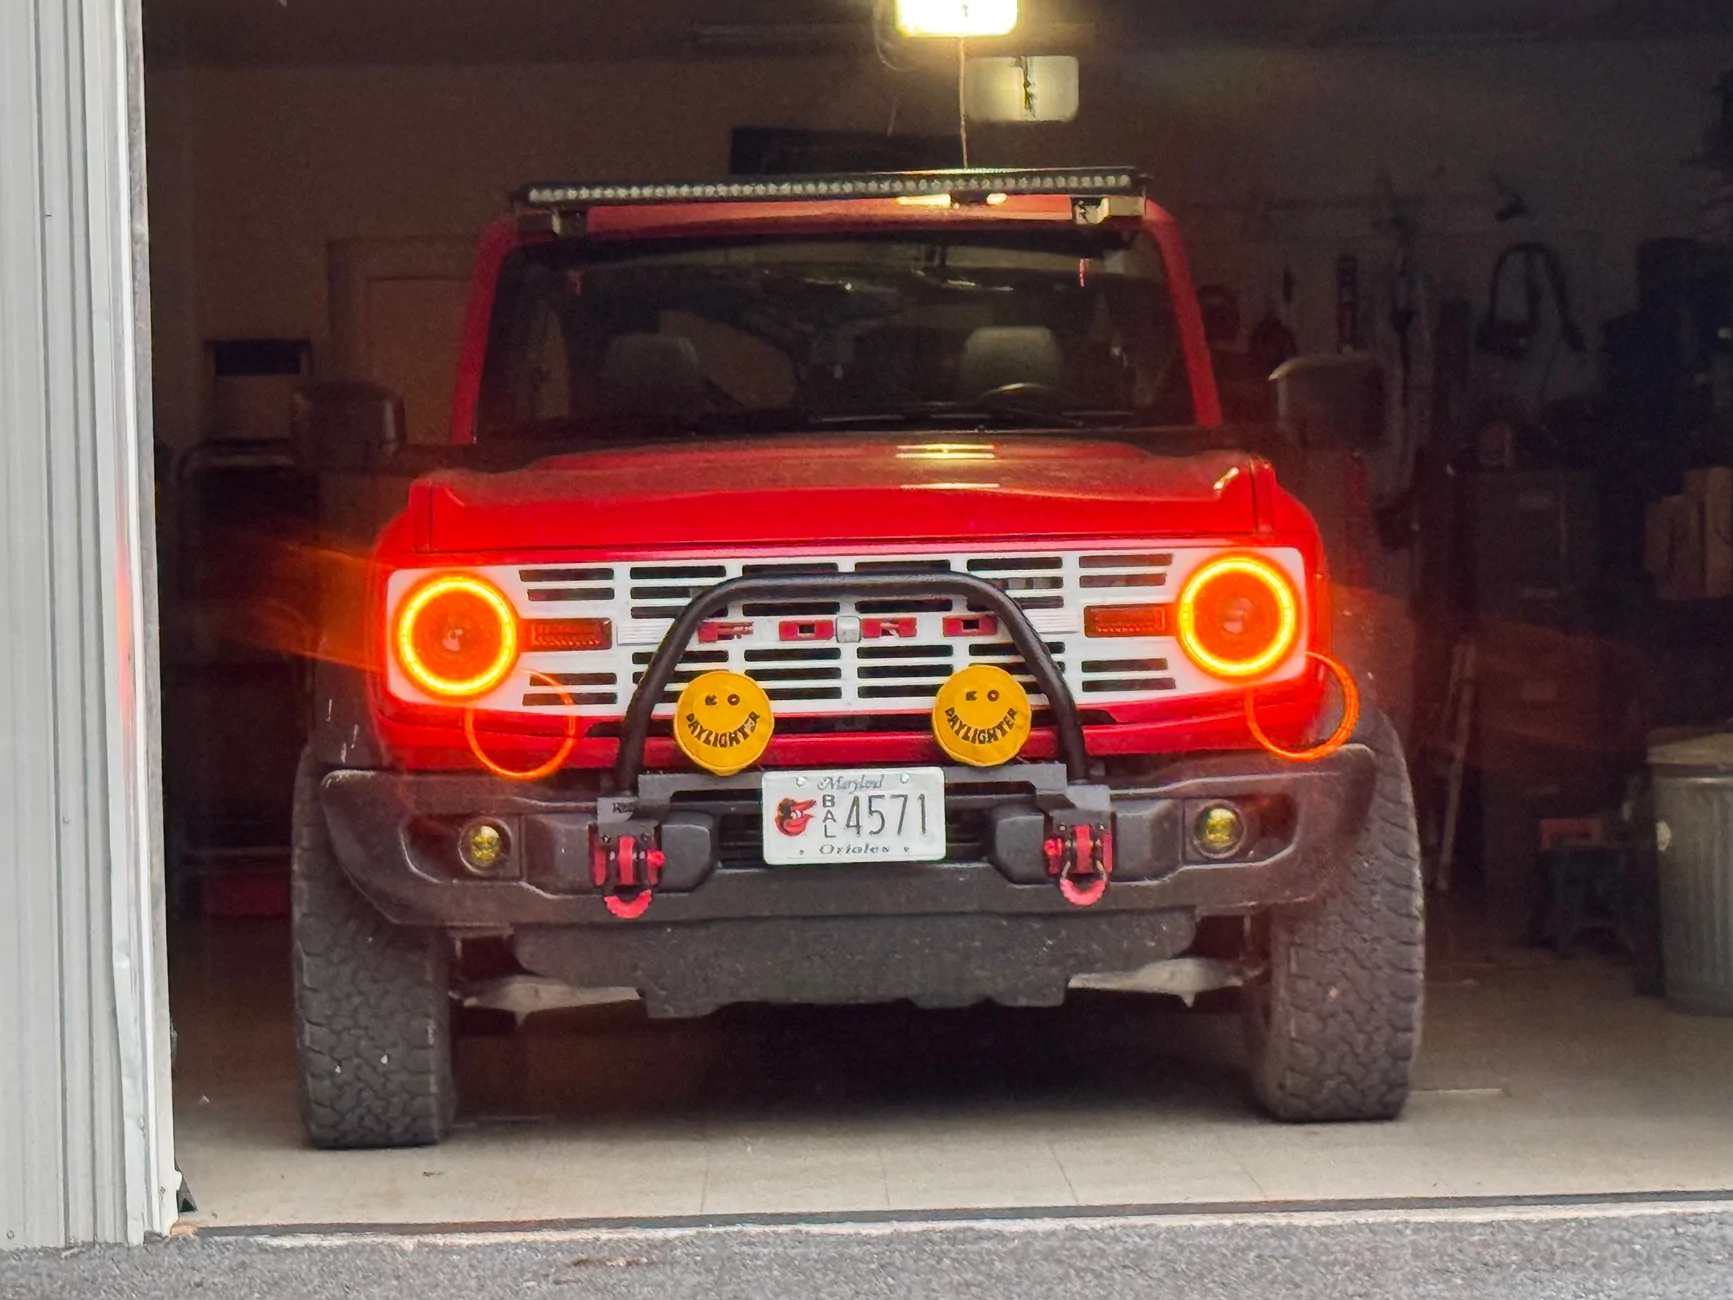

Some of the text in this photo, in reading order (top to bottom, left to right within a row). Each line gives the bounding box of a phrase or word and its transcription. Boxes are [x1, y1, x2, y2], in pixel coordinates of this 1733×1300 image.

[945, 707, 1018, 744] DAYLIGHTER
[845, 793, 926, 837] 4571
[820, 844, 890, 855] Orioles
